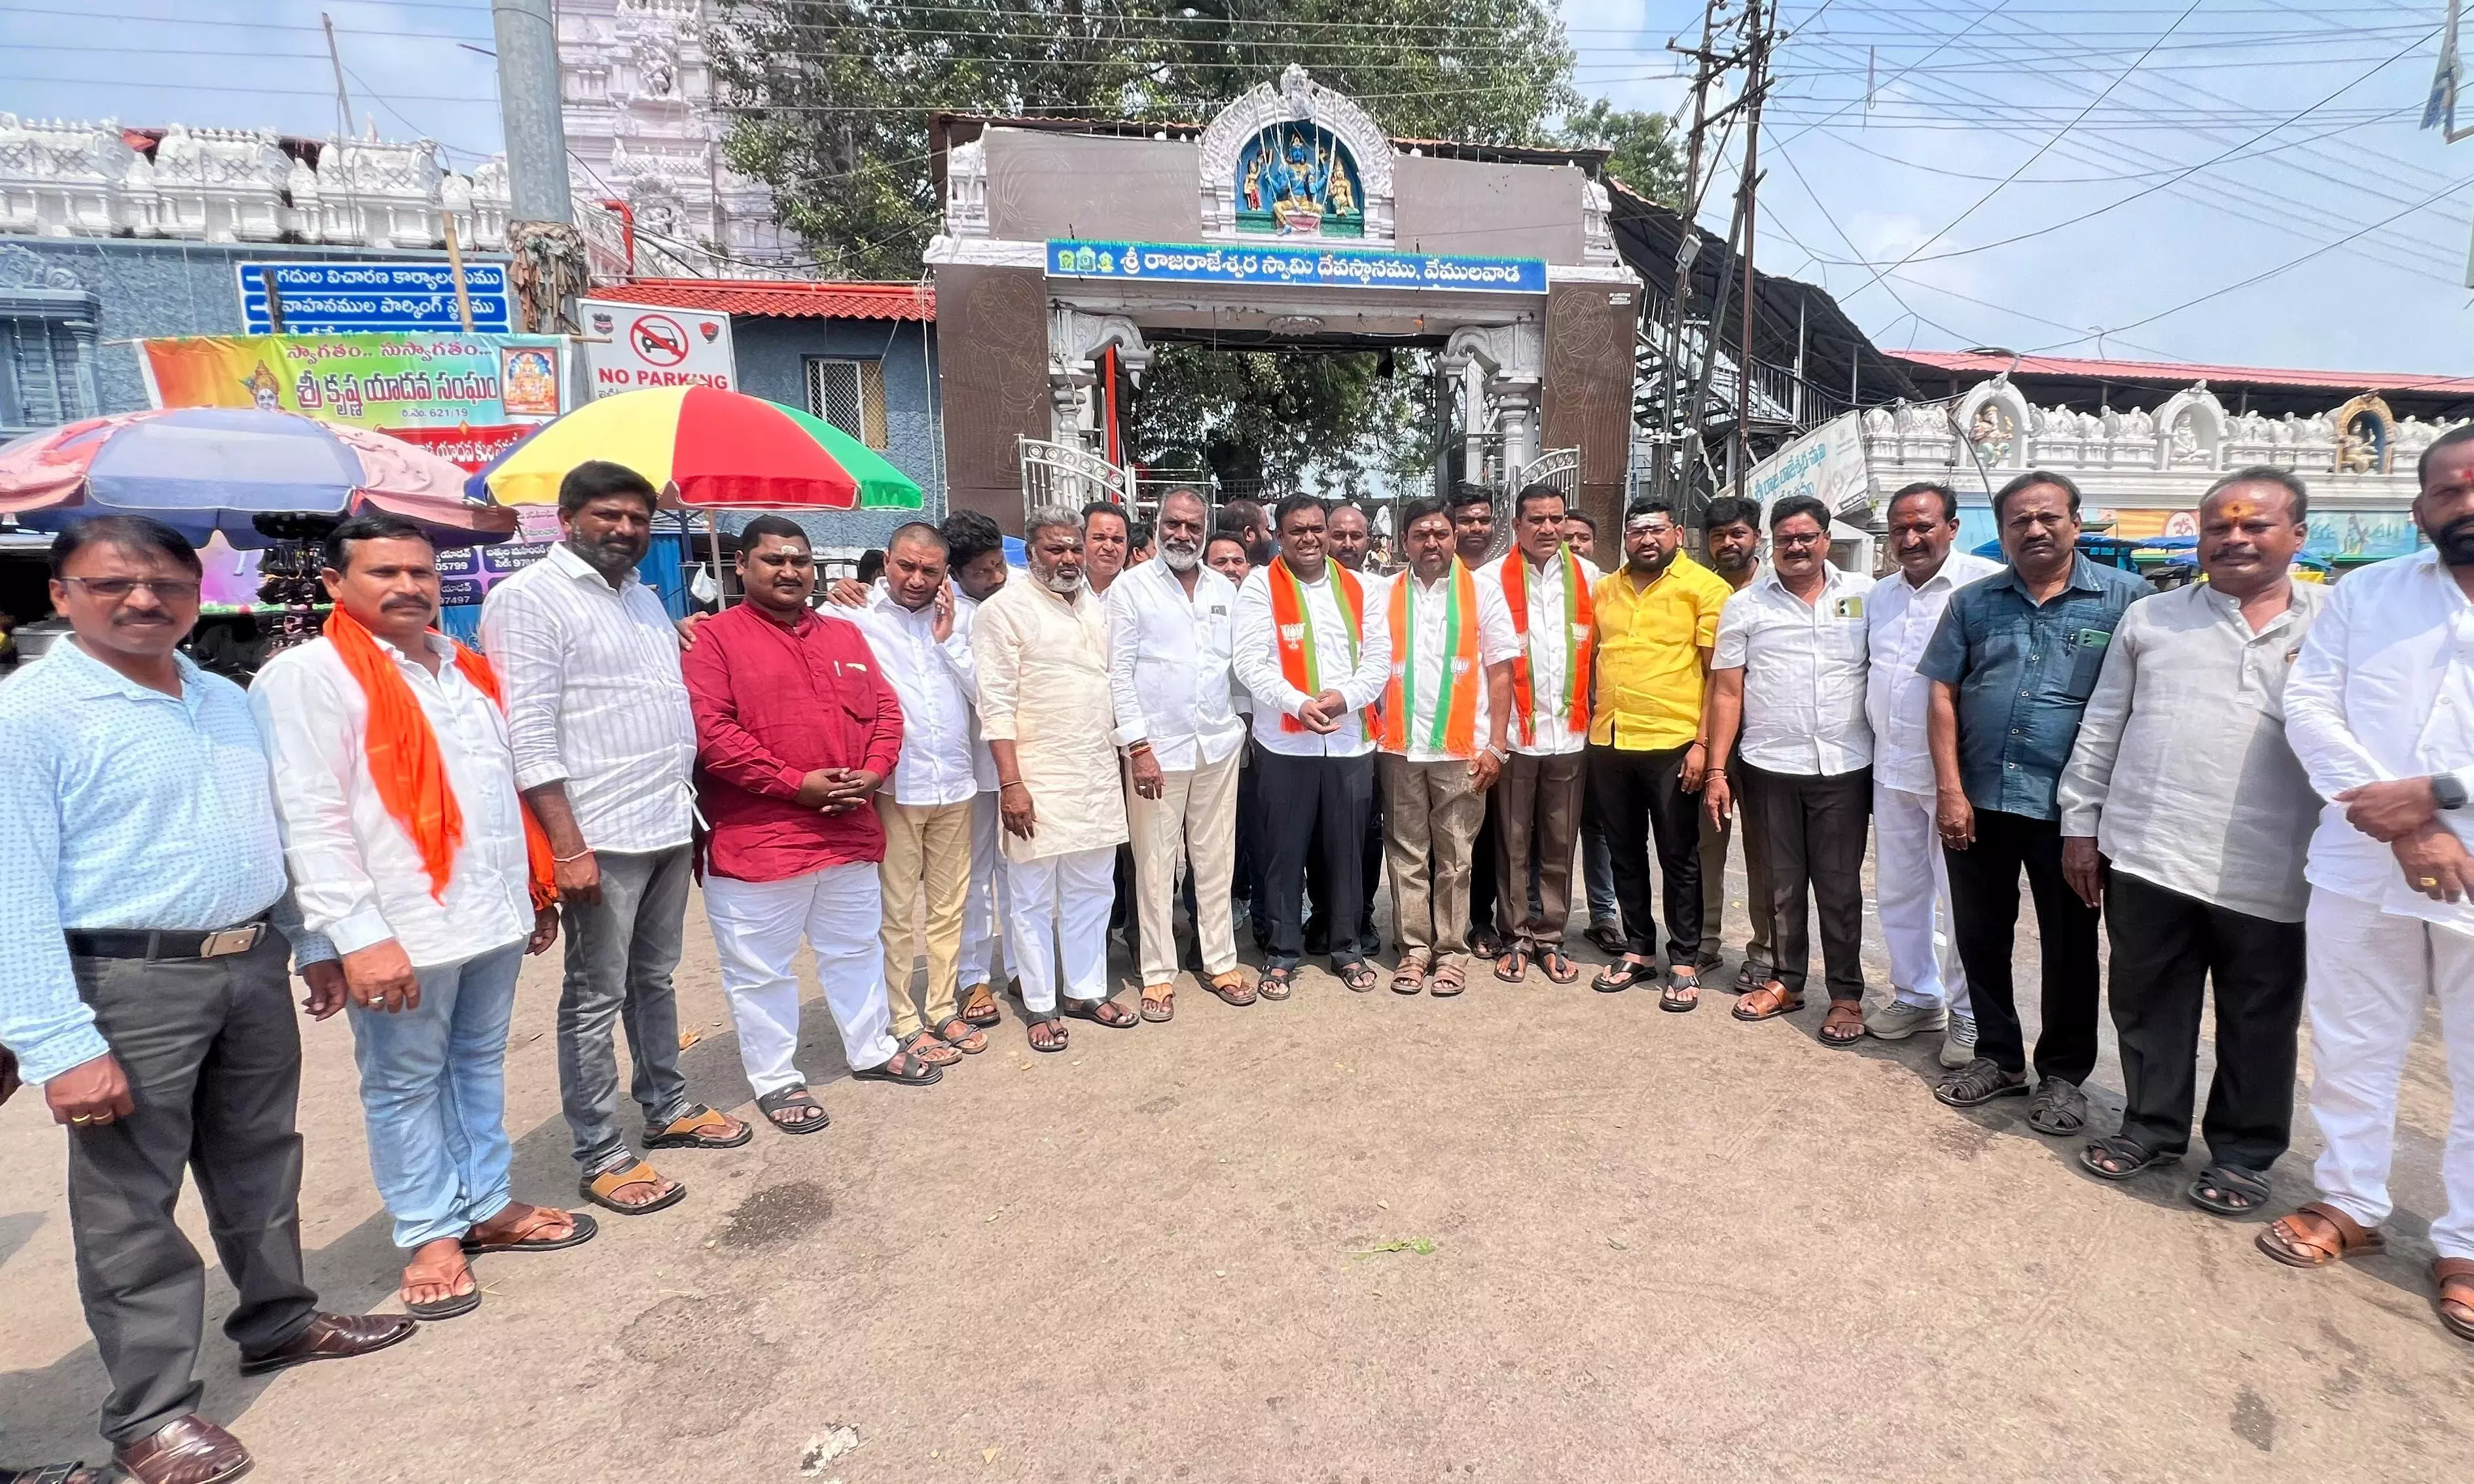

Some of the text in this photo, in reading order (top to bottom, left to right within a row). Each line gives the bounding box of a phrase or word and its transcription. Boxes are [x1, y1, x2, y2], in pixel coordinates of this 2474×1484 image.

[1120, 246, 1521, 285] శ్రీ రాజరాజేశ్వర స్వామి దేవస్థానము, వేములవాడ
[277, 269, 323, 283] గదుల
[327, 269, 389, 284] విచారణ
[281, 296, 495, 321] వాహనముల పార్కింగ్ స్థము
[598, 368, 630, 385] NO
[296, 369, 498, 416] శ్రీ కృష్ణ యాదవ సంఘం
[429, 408, 469, 417] 621/19
